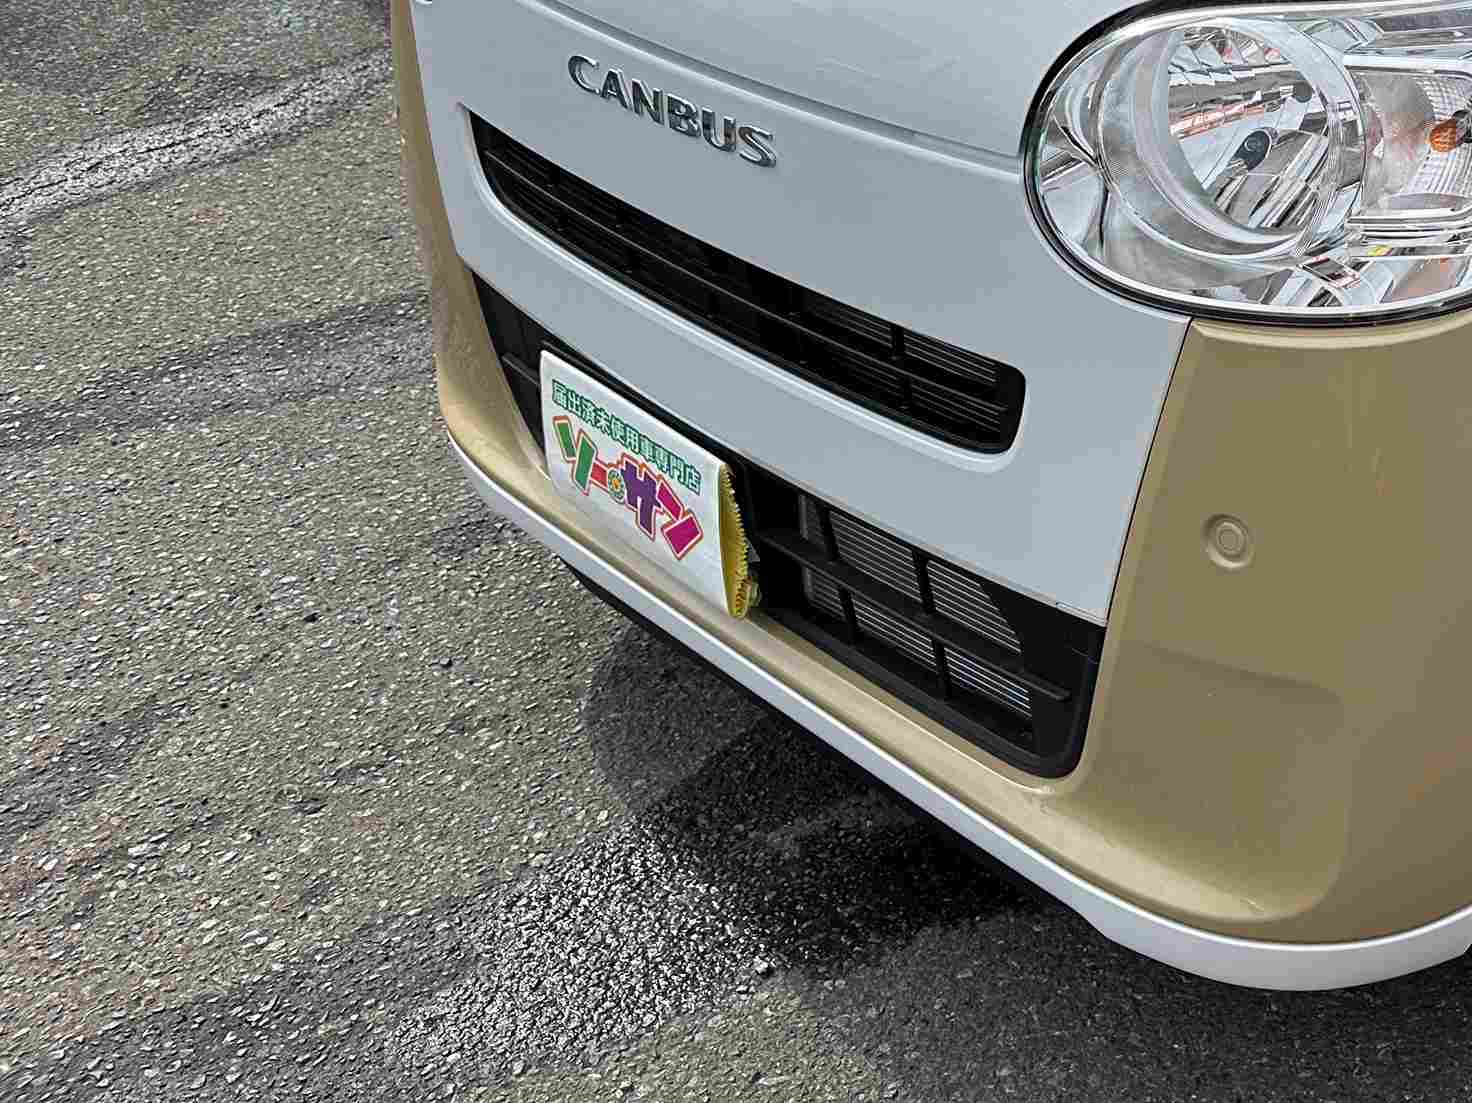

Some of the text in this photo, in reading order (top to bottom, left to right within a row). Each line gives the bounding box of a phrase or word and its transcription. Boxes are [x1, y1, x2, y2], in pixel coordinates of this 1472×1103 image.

[567, 55, 777, 168] CANBUS
[552, 379, 702, 497] 届出済未使用車専門店
